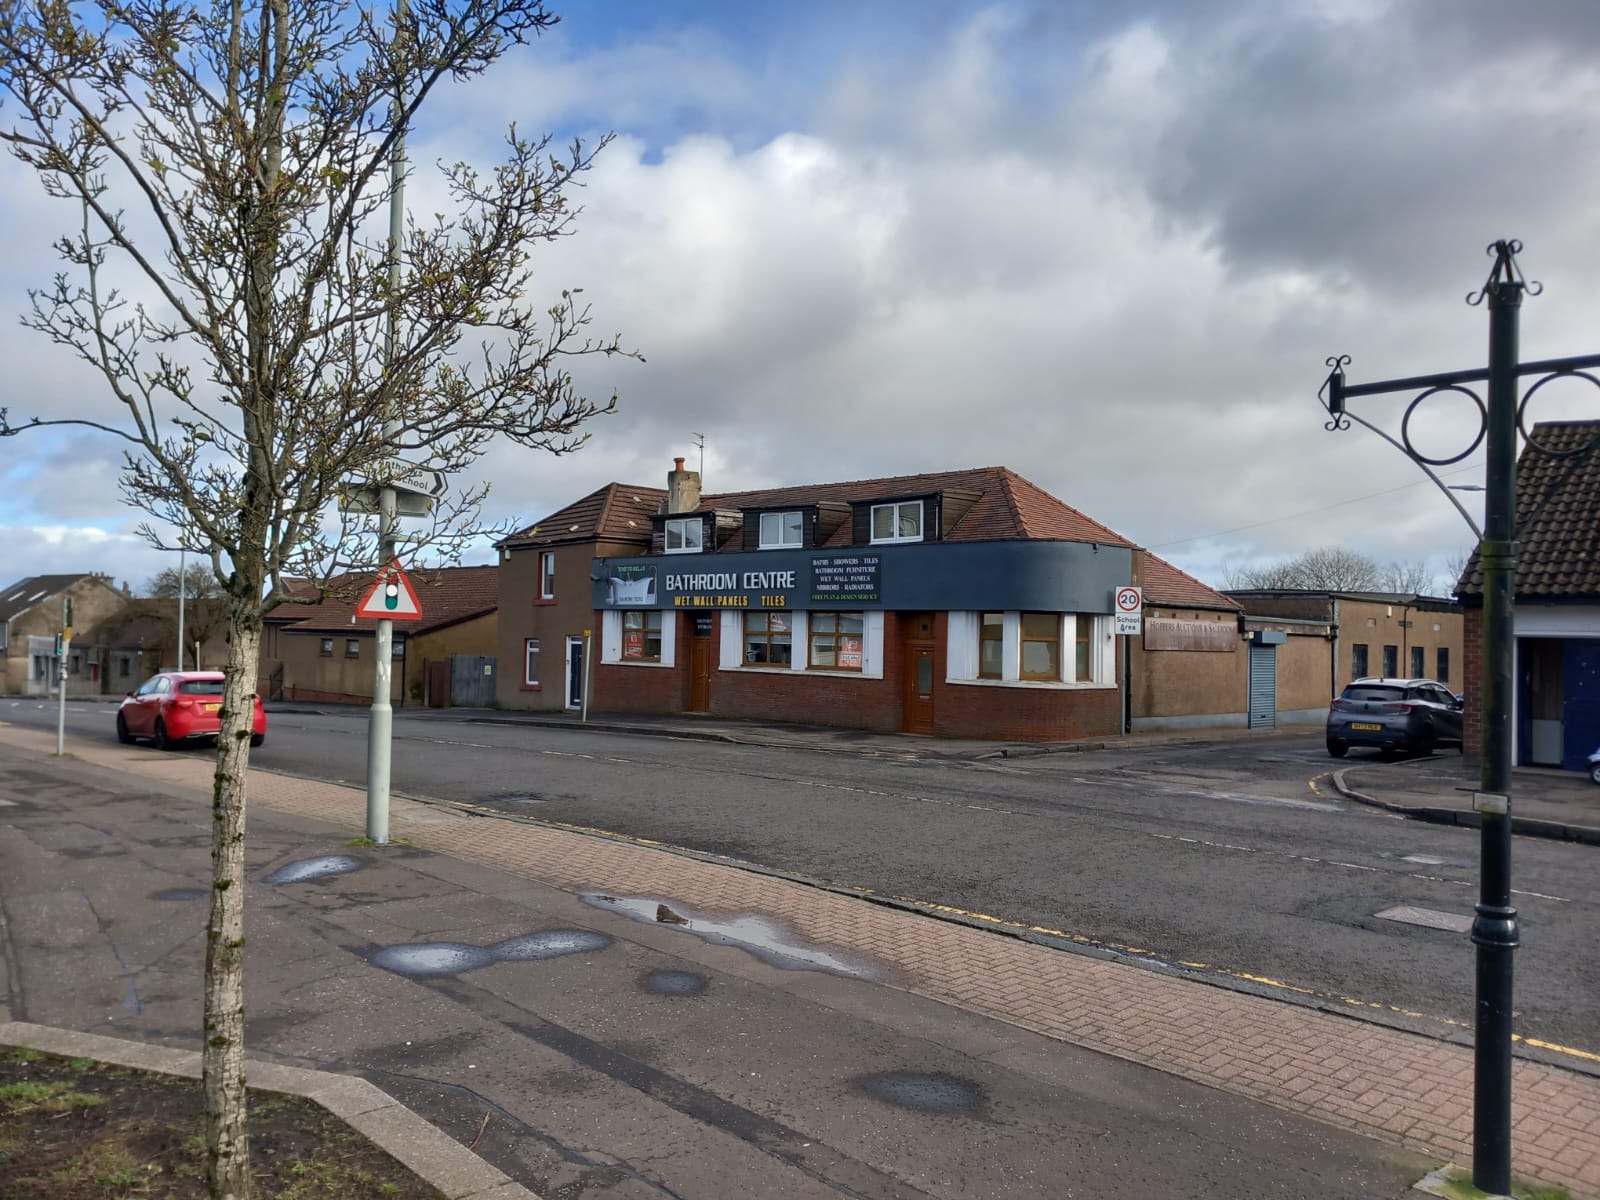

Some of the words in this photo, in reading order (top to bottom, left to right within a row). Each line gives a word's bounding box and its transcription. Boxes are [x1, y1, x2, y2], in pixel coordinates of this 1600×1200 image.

[401, 476, 428, 490] chool
[666, 573, 737, 591] BATHROOM
[743, 571, 795, 589] CENTRE
[844, 583, 875, 591] RADIATORS
[674, 596, 690, 606] WET
[693, 596, 714, 606] WALL
[717, 595, 748, 606] PANELS
[761, 595, 785, 606] TILES
[1121, 594, 1136, 604] 20
